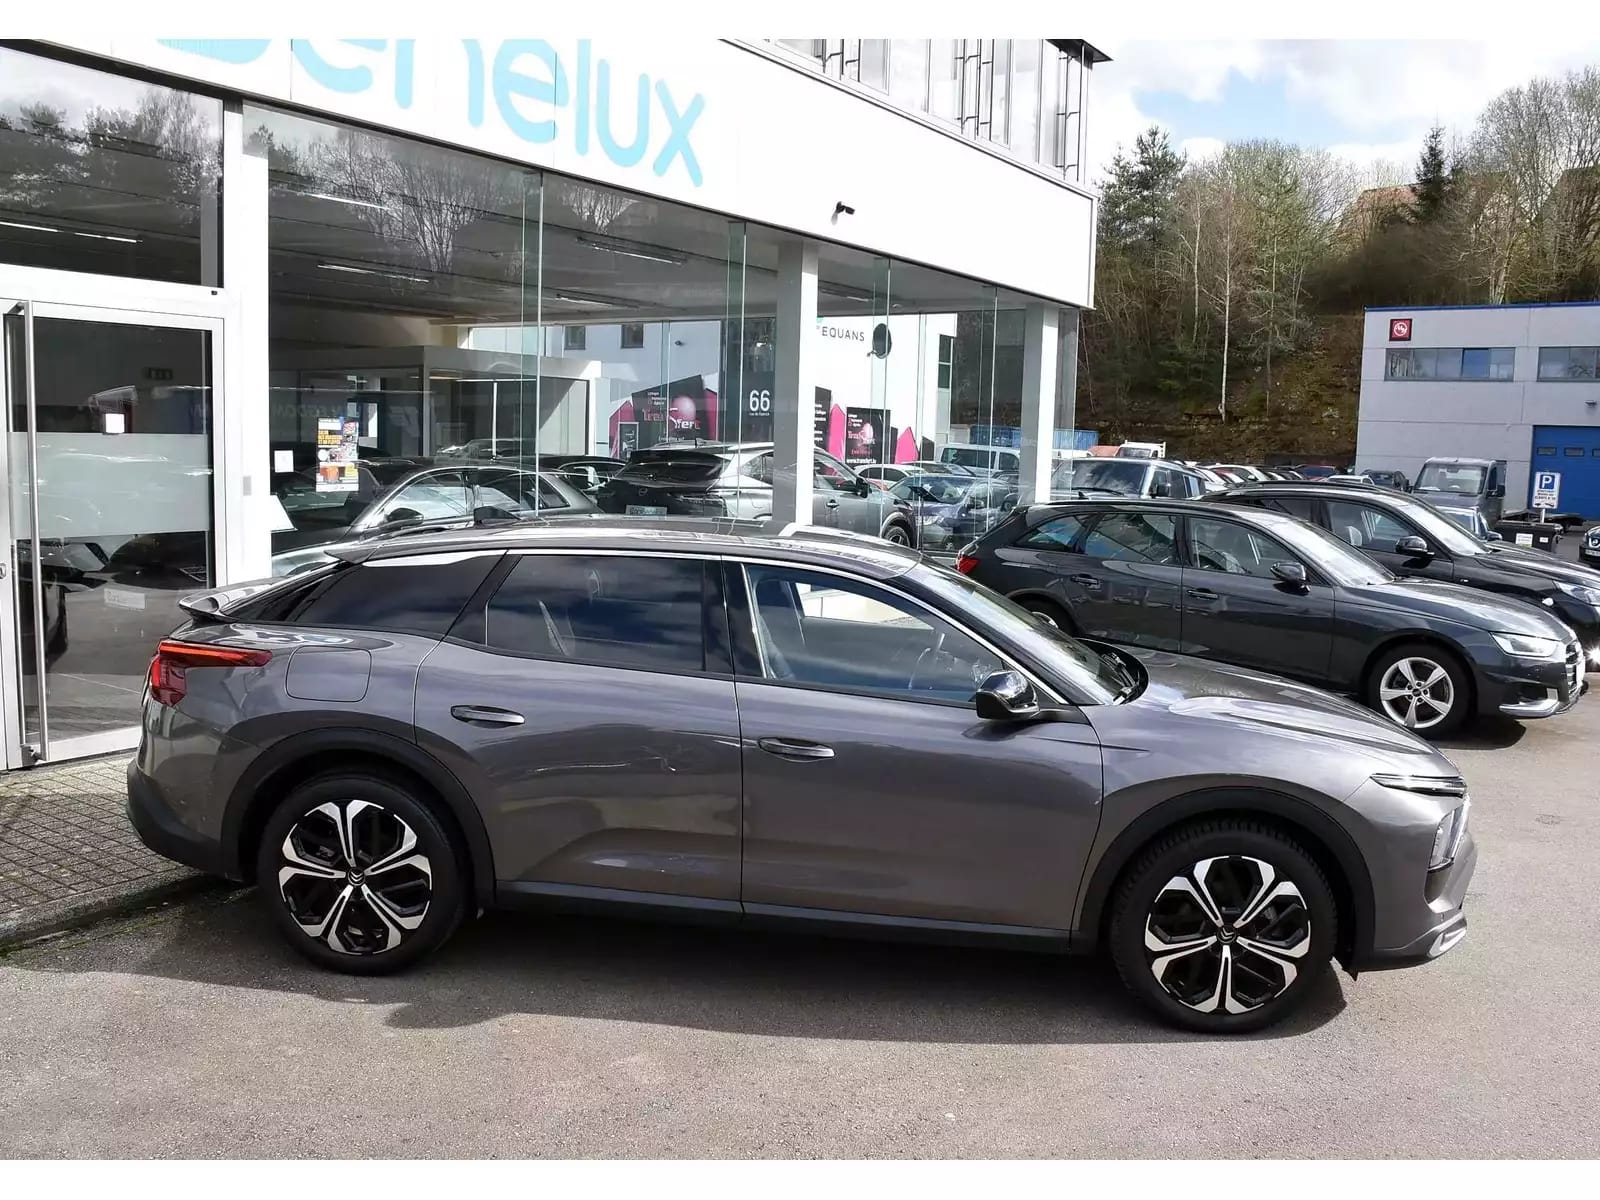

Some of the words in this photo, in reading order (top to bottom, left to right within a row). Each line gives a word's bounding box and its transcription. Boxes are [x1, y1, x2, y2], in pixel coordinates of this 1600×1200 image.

[157, 39, 704, 187] nelux
[822, 326, 865, 342] EQUANS
[749, 389, 770, 412] 66
[1541, 475, 1553, 489] P
